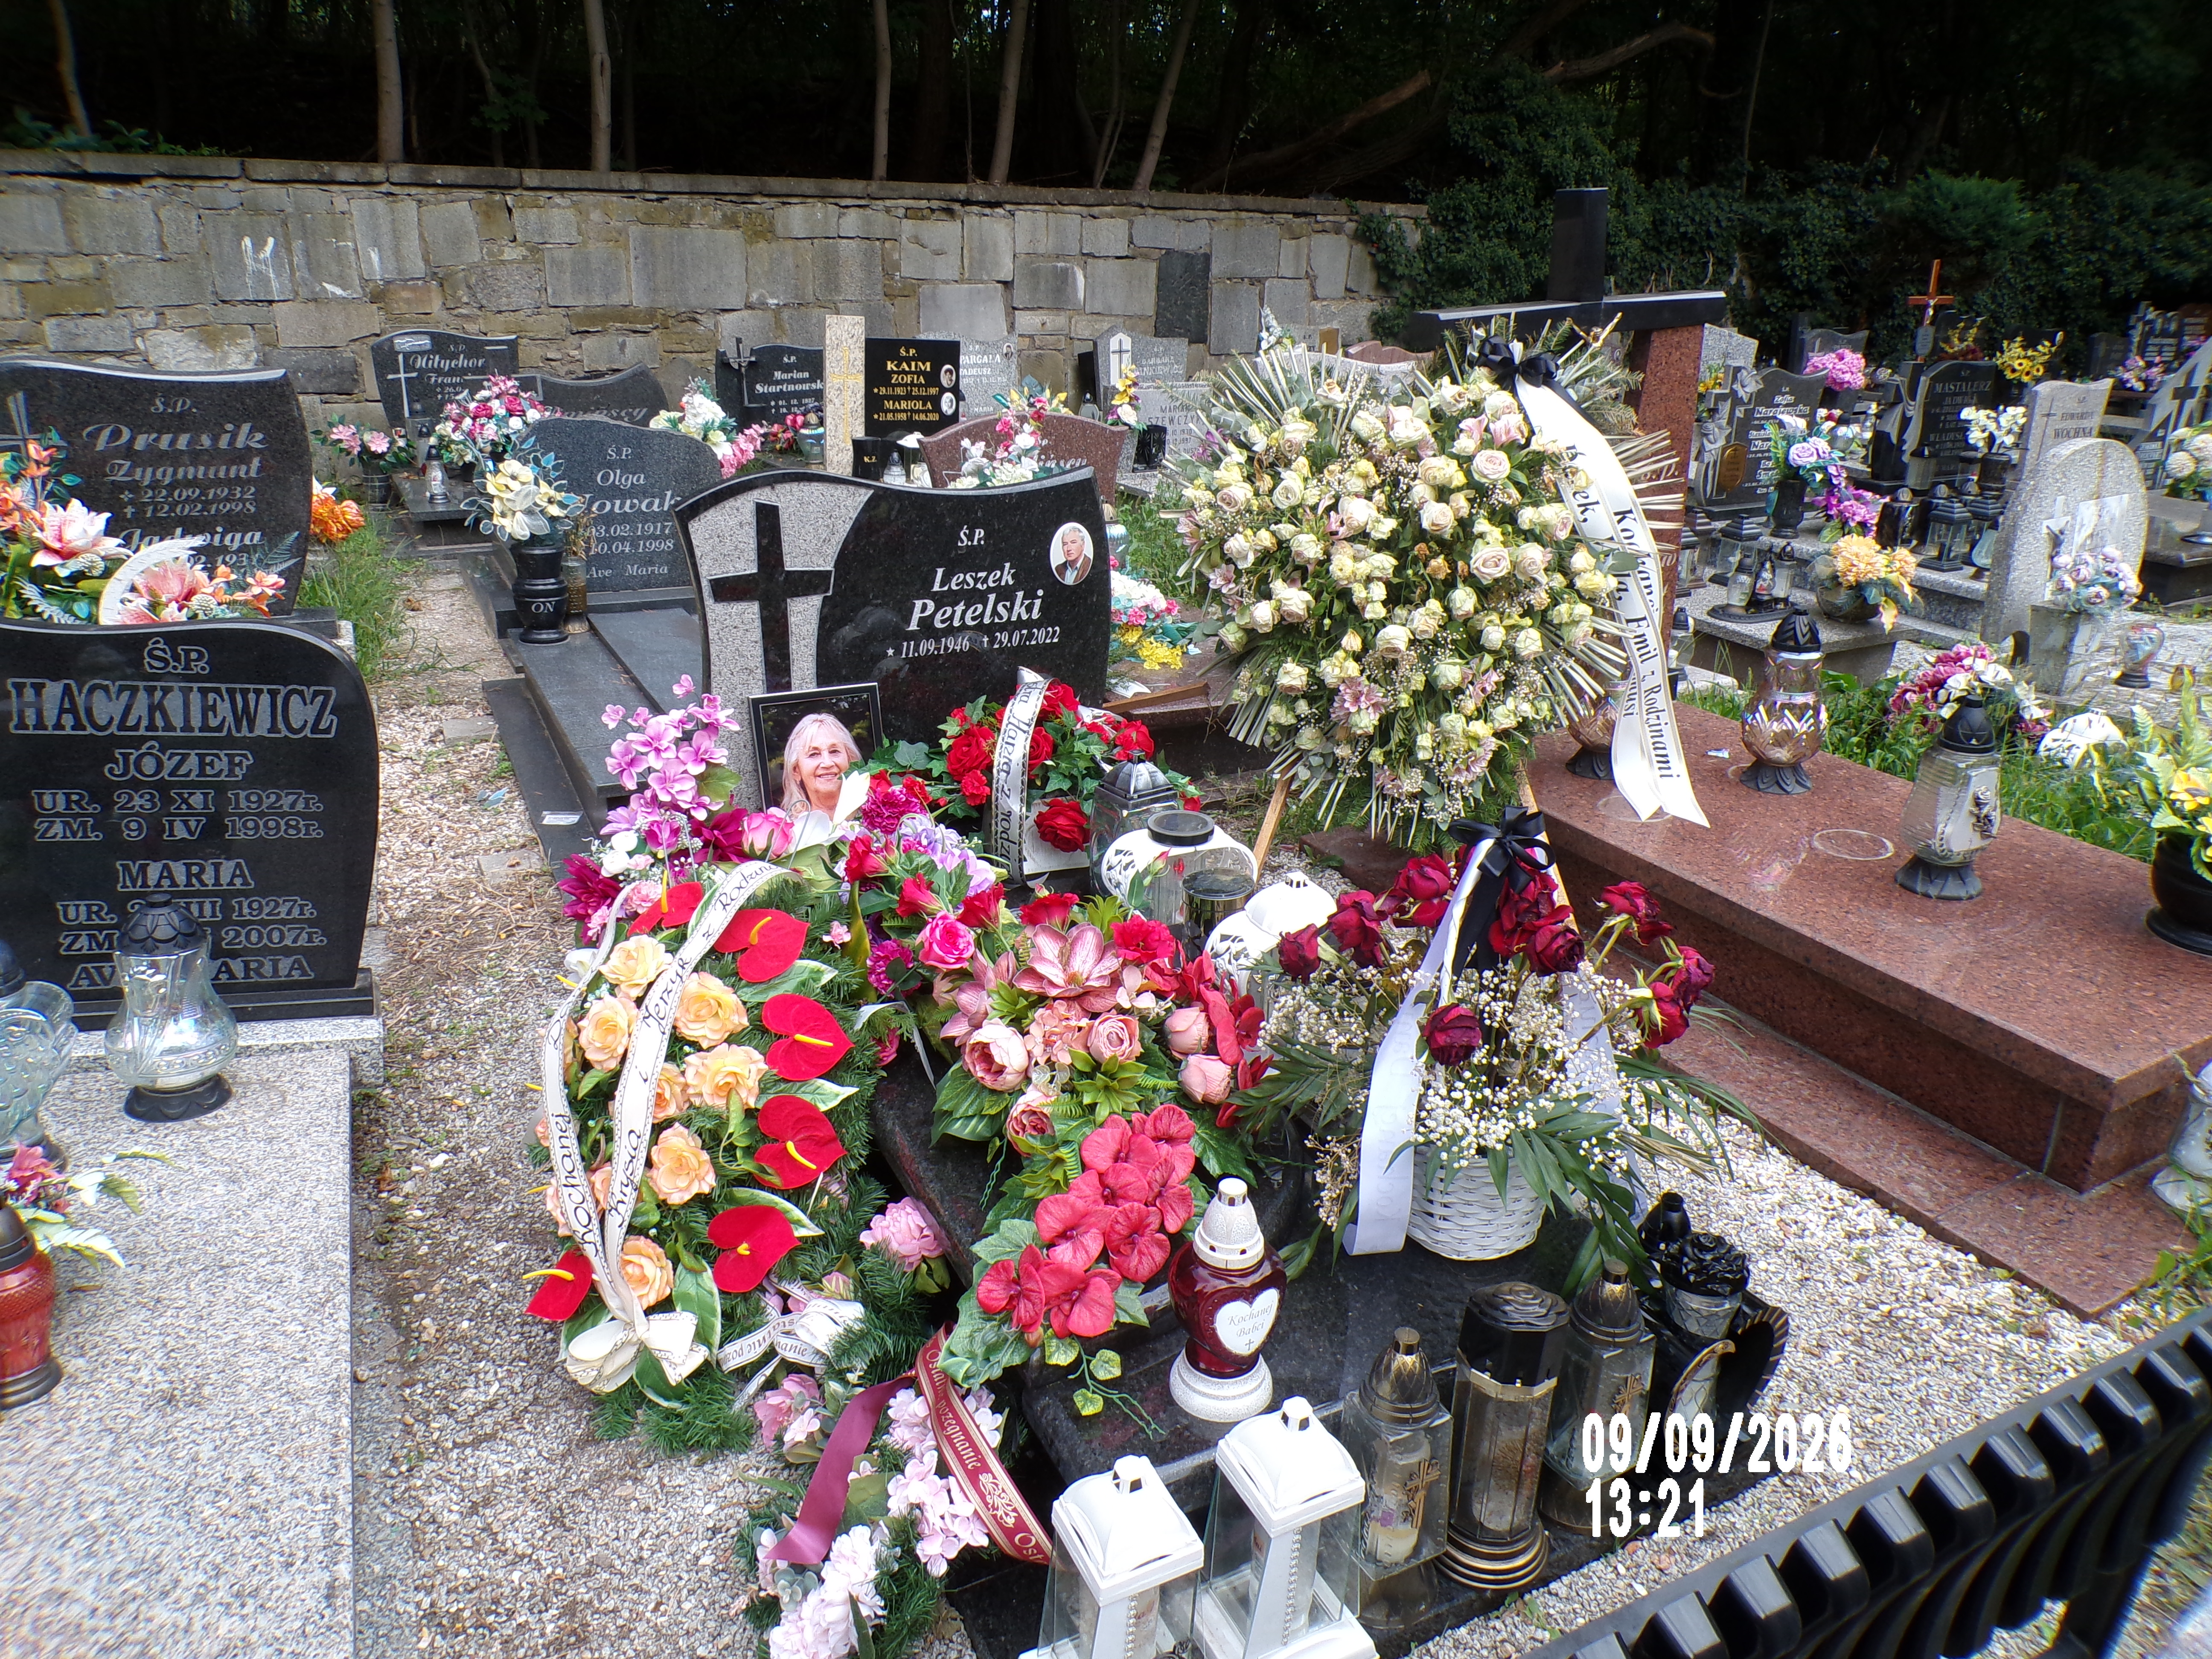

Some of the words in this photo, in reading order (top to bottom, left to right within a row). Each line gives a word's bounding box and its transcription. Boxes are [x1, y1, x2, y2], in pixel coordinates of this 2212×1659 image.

[899, 346, 917, 356] Ś.P.
[773, 370, 809, 380] Marian
[886, 361, 931, 371] KAIM
[755, 379, 824, 393] Startnowsk
[879, 386, 906, 395] 29.11.1923
[912, 387, 939, 395] 25.12.1997
[891, 374, 925, 384] ZOFIA
[879, 412, 907, 421] 21.05.1958
[884, 400, 932, 410] MARIOLA
[83, 423, 269, 451] Prusik
[607, 445, 632, 460] Ś.P.
[104, 457, 265, 486] Zygmunt
[597, 469, 646, 489] Olga
[138, 486, 256, 502] 22.09.1932
[145, 501, 256, 517] 12.02.1998
[590, 538, 674, 555] 10.04.1998
[958, 526, 985, 546] Ś.P.
[587, 566, 612, 578] Ave
[625, 564, 668, 576] Maria
[931, 562, 1015, 593] Leszek
[531, 601, 556, 613] ON
[905, 588, 1044, 631] Petelski
[901, 635, 970, 659] 11.09.1946
[993, 626, 1061, 649] 29.07.2022
[144, 637, 210, 674] Ś.P.
[8, 678, 339, 738] HACZKIEWICZ
[1625, 614, 1659, 665] Emil
[1643, 683, 1681, 780] Rodzinami
[105, 741, 253, 780] JÓZEF
[32, 790, 101, 813] UR.
[114, 790, 160, 813] 23
[171, 789, 215, 812] XI
[228, 789, 324, 813] 1927r.
[34, 818, 103, 841] ZM.
[122, 818, 147, 841] 9
[163, 817, 207, 840] IV
[225, 816, 324, 840] 1998r.
[117, 859, 255, 891] MARIA
[56, 900, 118, 925] UR.
[233, 896, 317, 920] 1927r.
[222, 925, 327, 949] 2007r.
[212, 955, 314, 982] ARIA
[551, 1112, 599, 1257] Kochanej
[608, 1129, 641, 1228] Krysia
[1228, 1301, 1275, 1327] Kochanej
[1236, 1318, 1266, 1337] Babci
